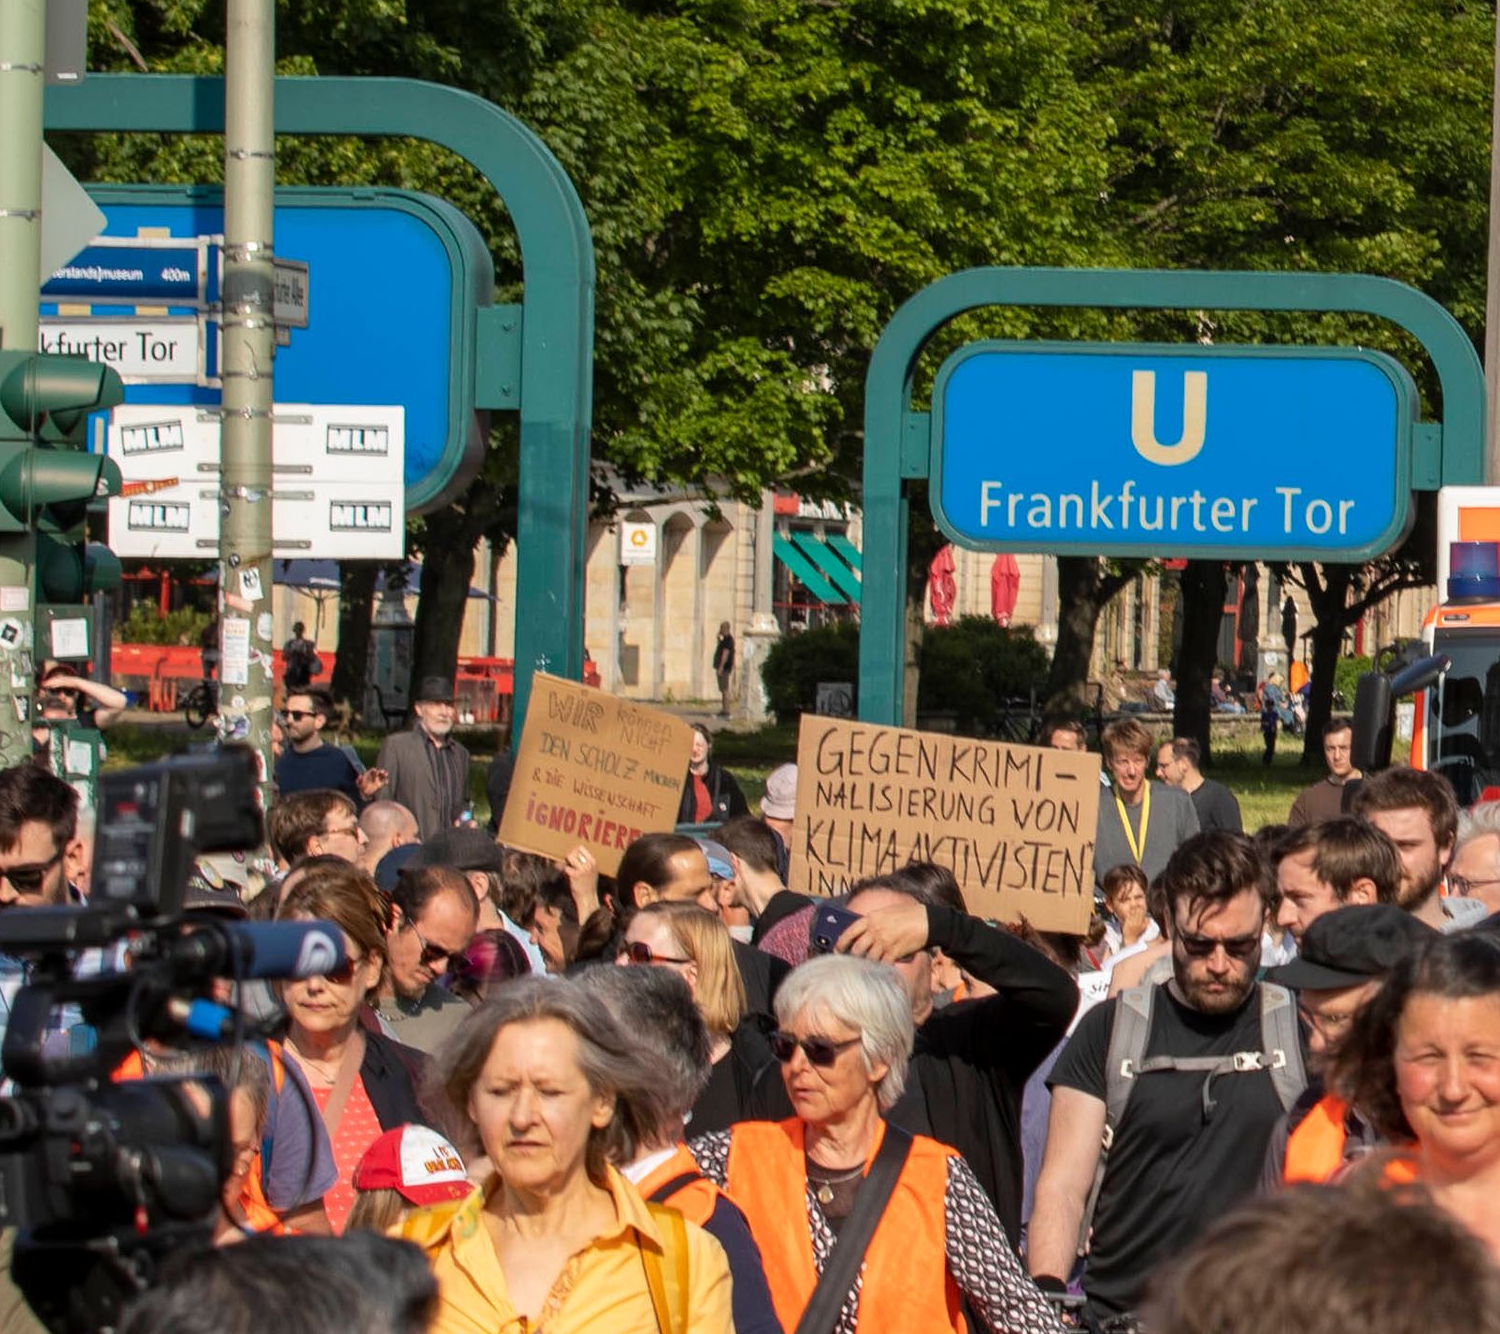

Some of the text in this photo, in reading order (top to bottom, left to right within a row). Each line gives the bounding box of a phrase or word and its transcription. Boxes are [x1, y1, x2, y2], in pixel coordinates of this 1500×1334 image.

[161, 267, 190, 282] 400m
[136, 332, 177, 361] Tor
[1131, 370, 1207, 466] U
[122, 422, 183, 454] MLM
[327, 426, 388, 454] MLM
[129, 503, 190, 530] MLM
[330, 503, 391, 530] MLM
[980, 480, 1354, 534] Frankfurter Tor
[539, 732, 571, 761] DEN
[574, 743, 638, 781] SCHOLZ
[816, 728, 938, 780] GEGEN
[816, 782, 1080, 833] NALISIERUNG VON
